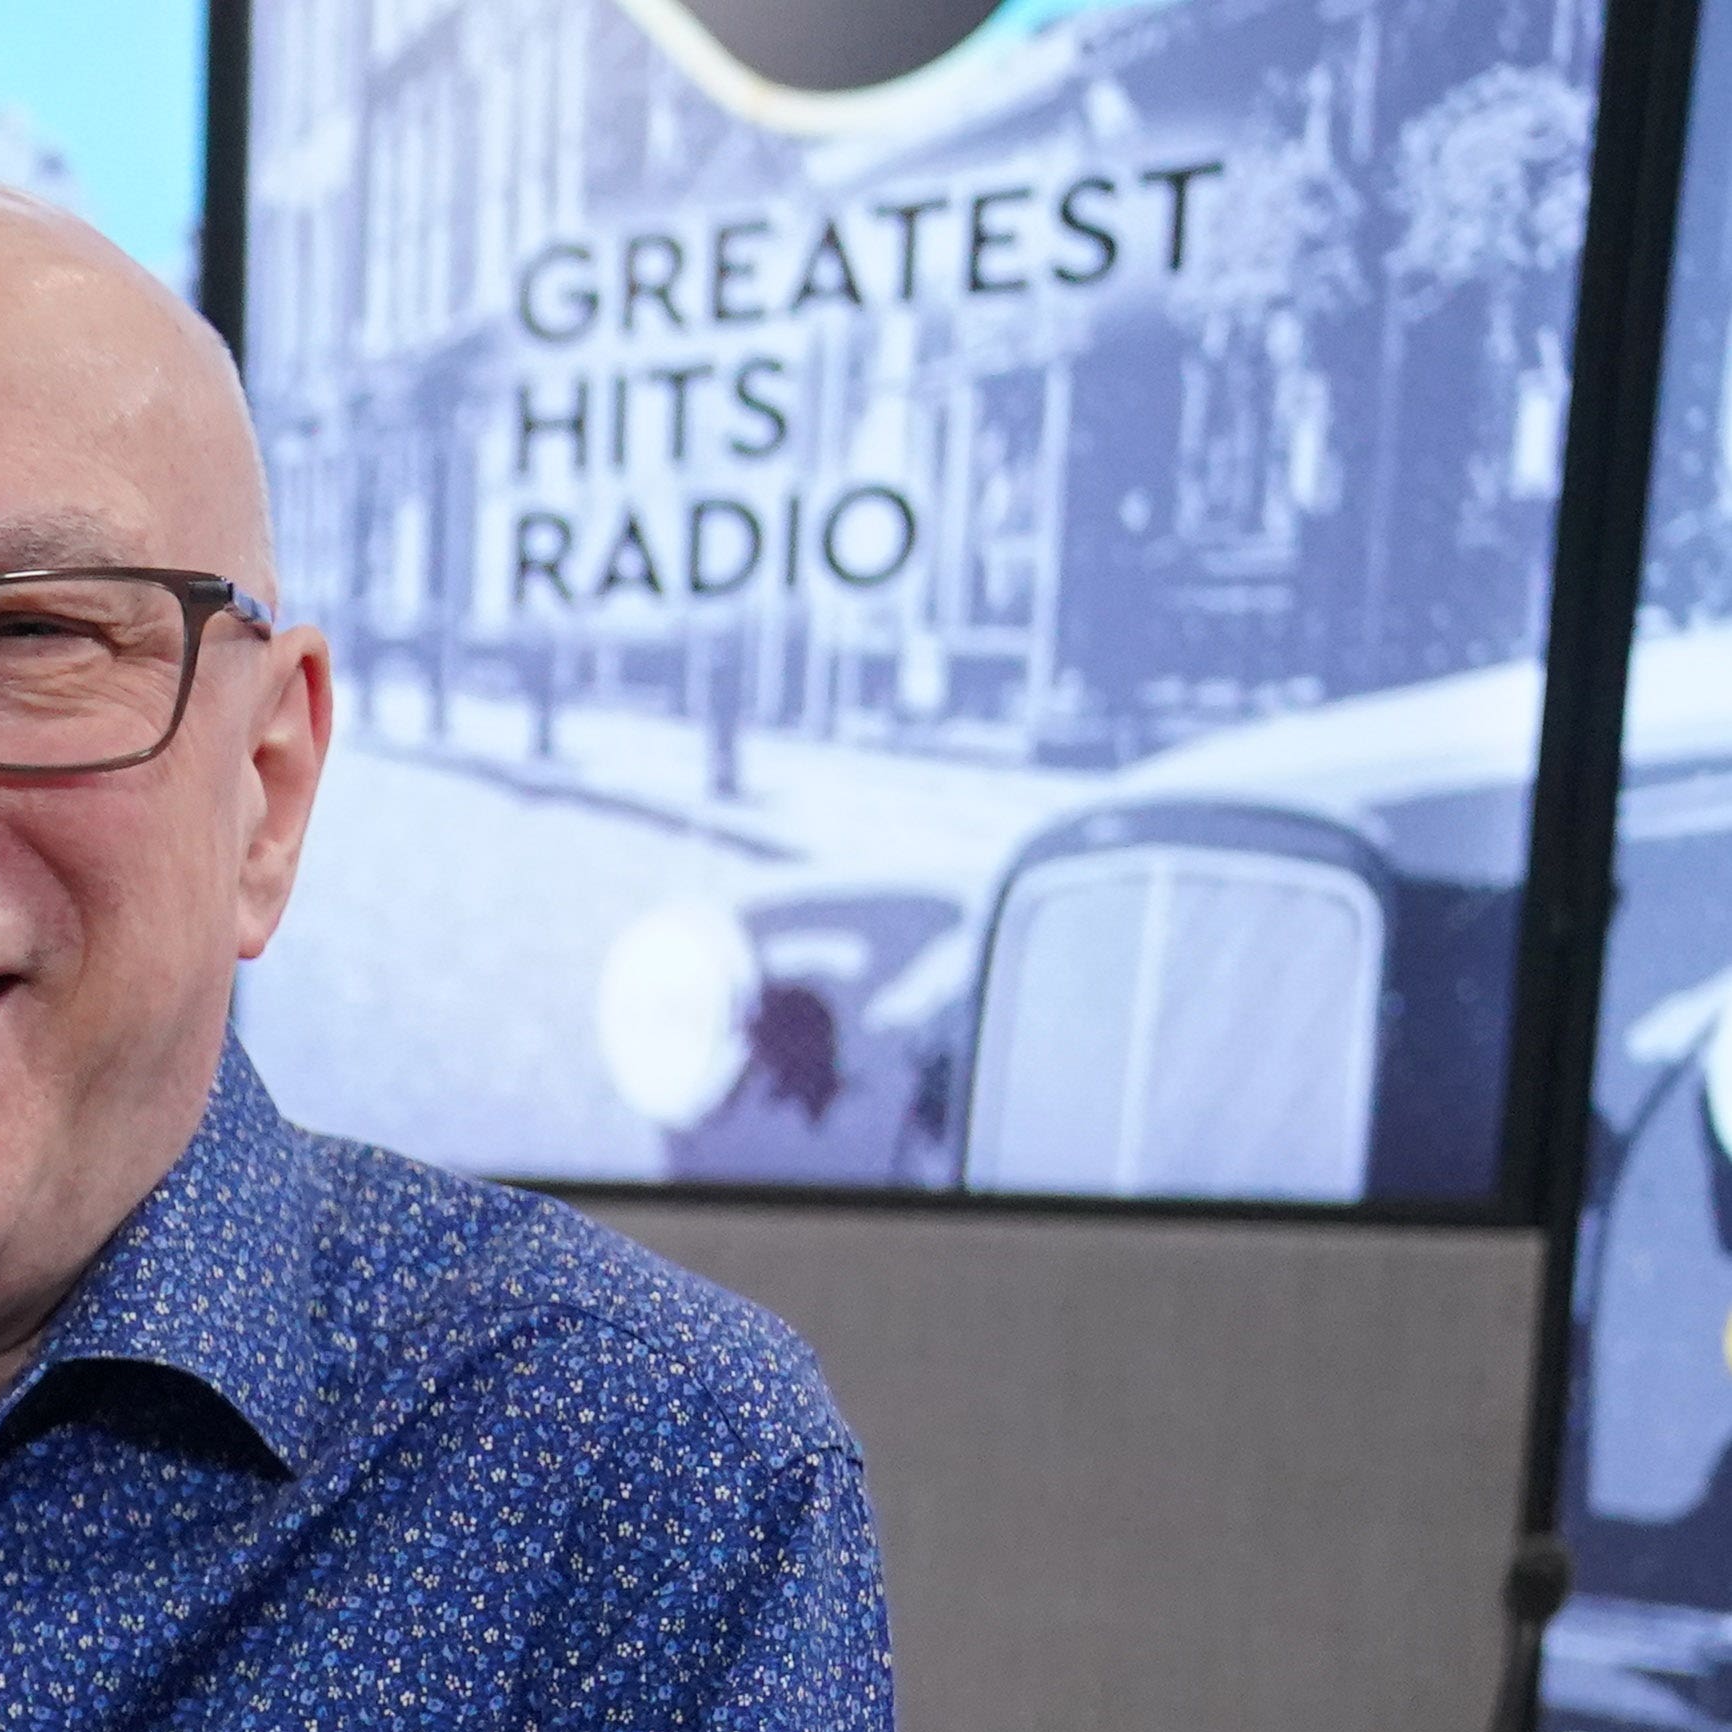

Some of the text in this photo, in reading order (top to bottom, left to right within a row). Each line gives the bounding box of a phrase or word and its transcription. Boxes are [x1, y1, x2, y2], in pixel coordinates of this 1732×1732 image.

[517, 159, 1225, 344] GREATEST
[515, 357, 790, 471] HITS
[514, 486, 916, 602] RADIO
